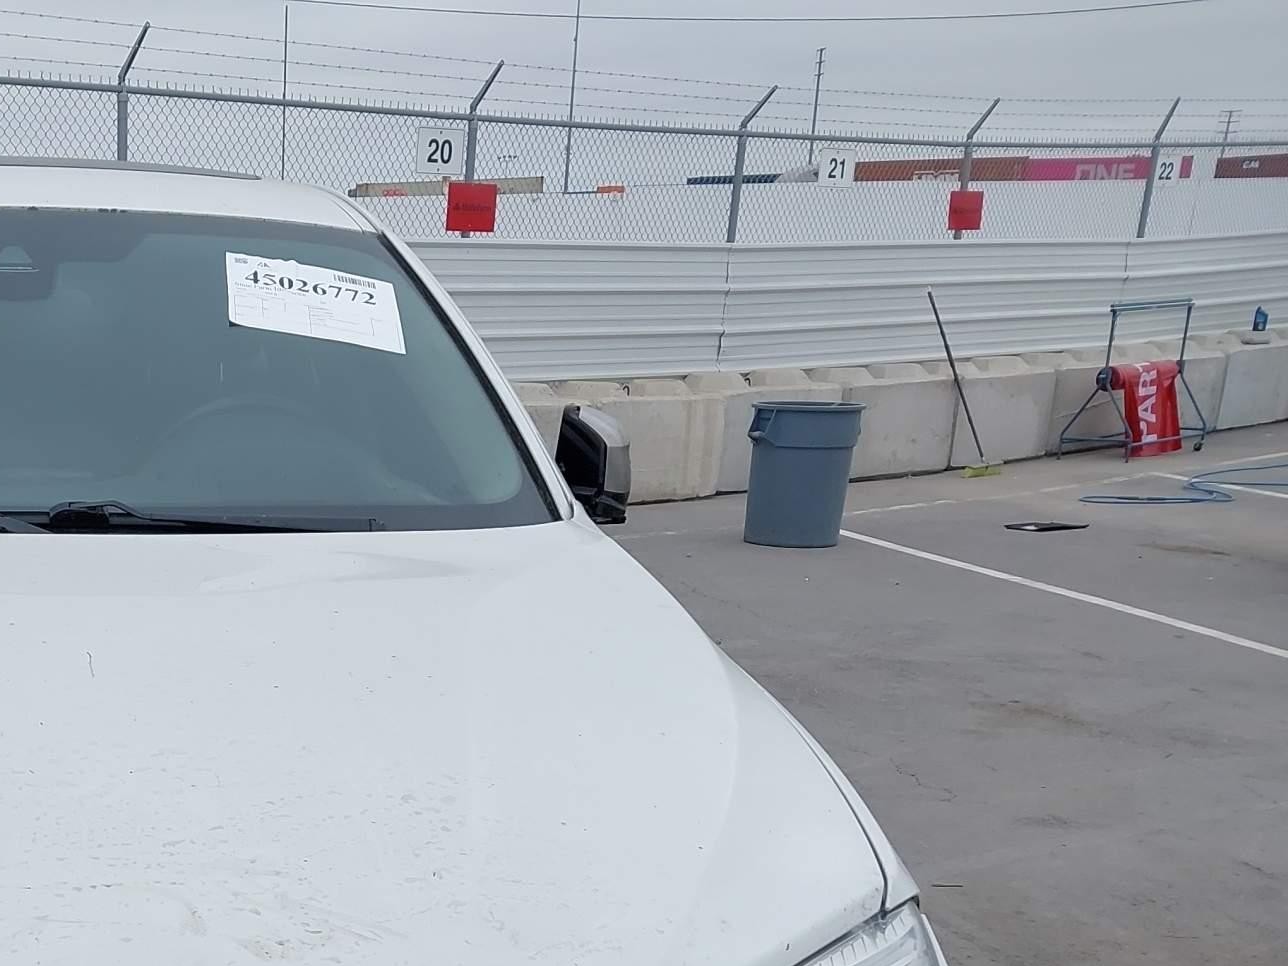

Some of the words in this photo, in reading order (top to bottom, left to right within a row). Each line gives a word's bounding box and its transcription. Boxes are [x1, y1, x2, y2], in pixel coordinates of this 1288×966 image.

[426, 138, 453, 164] 20
[827, 157, 846, 179] 21
[1158, 161, 1175, 181] 22
[244, 269, 378, 306] 45026772
